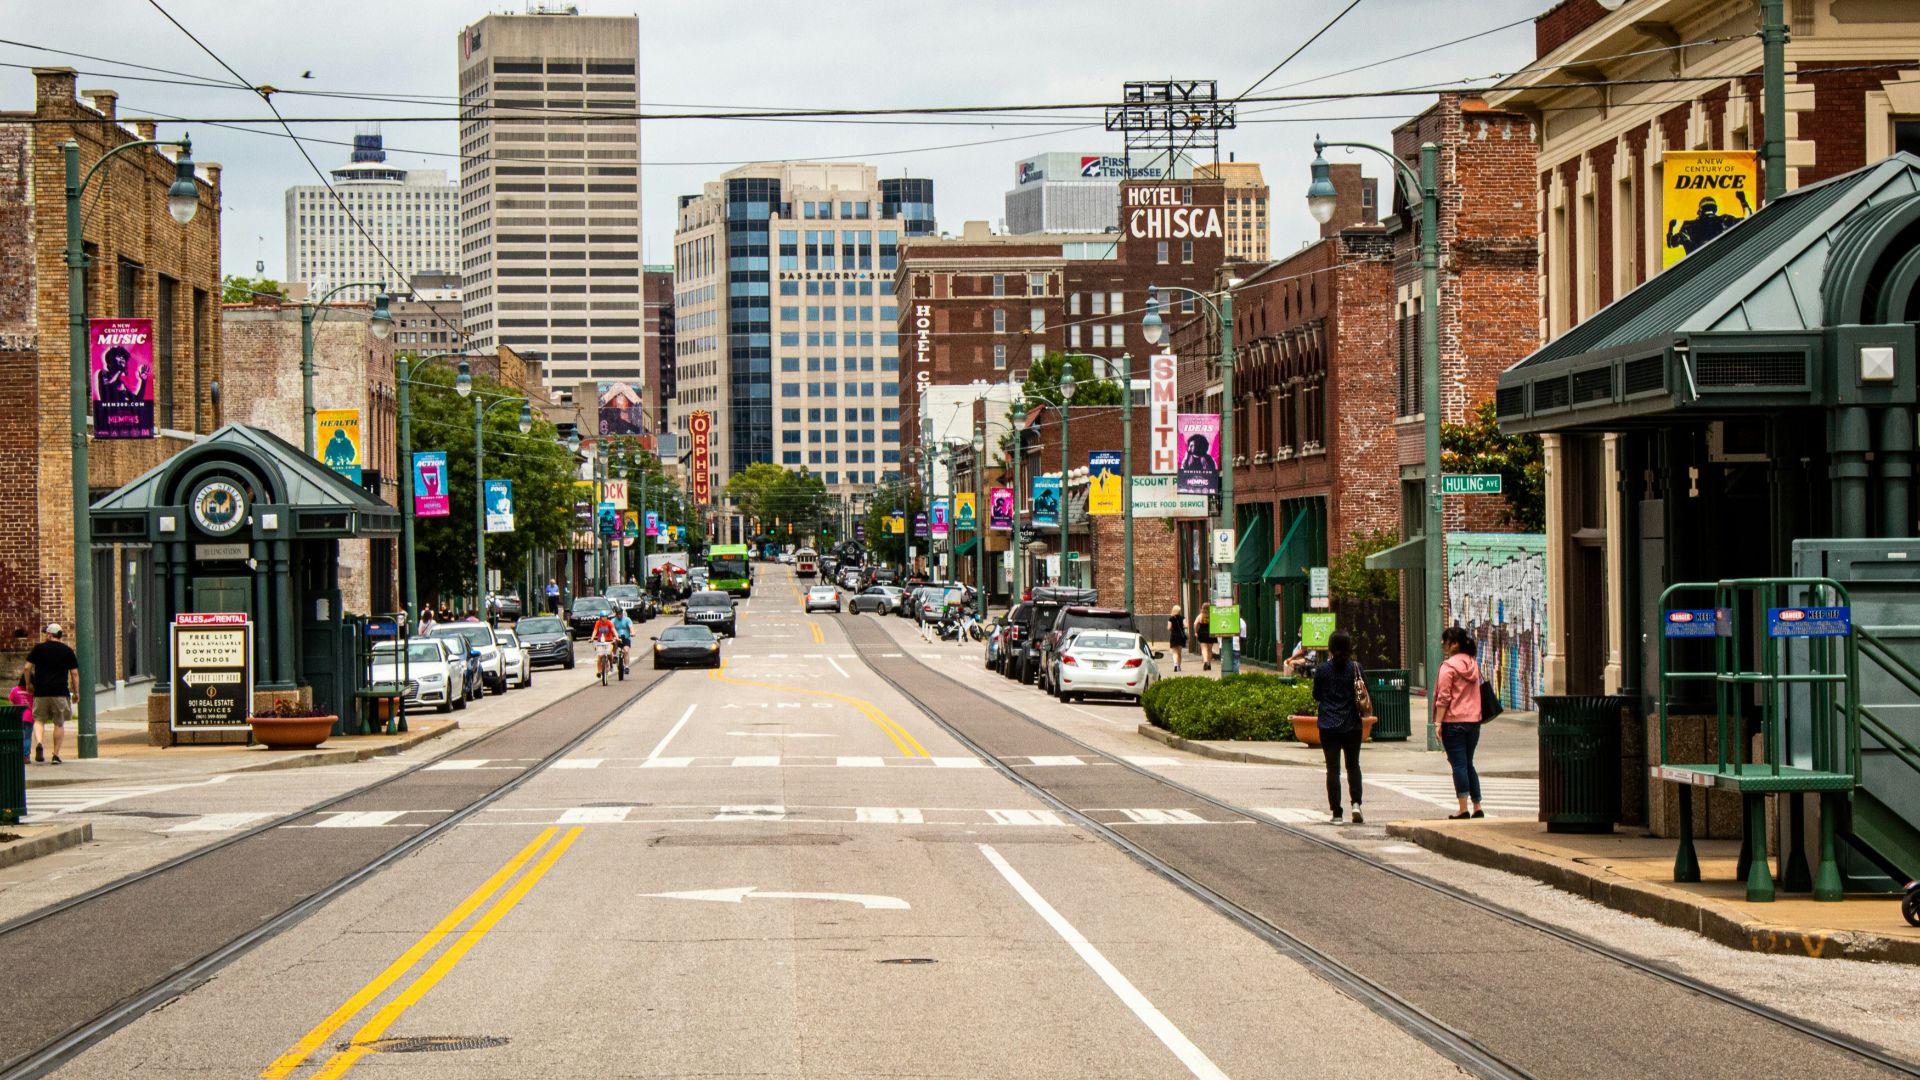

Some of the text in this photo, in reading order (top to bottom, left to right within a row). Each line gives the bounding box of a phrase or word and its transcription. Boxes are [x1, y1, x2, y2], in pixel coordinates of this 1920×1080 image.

[1102, 156, 1130, 166] FIRST
[1101, 167, 1161, 177] TENNESSEE
[1675, 175, 1746, 189] DANCE
[1128, 187, 1181, 205] HOTEL
[1130, 208, 1223, 238] CHISCA
[779, 272, 812, 280] BASS
[817, 272, 858, 280] BERRY
[916, 305, 931, 363] HOTEL
[97, 334, 147, 345] MUSIC
[1153, 358, 1175, 471] SMITH
[320, 419, 357, 427] HEALTH
[1183, 424, 1214, 432] IDEAS
[1446, 477, 1499, 491] HULING AVE
[1160, 500, 1177, 508] FOOD
[1180, 500, 1205, 508] SERVICE
[179, 615, 204, 623] SALES
[215, 615, 244, 623] RENTAL
[1696, 612, 1712, 621] KEEP
[1808, 610, 1839, 619] KEEP OFF
[188, 699, 234, 707] 901 REAL ESTATE
